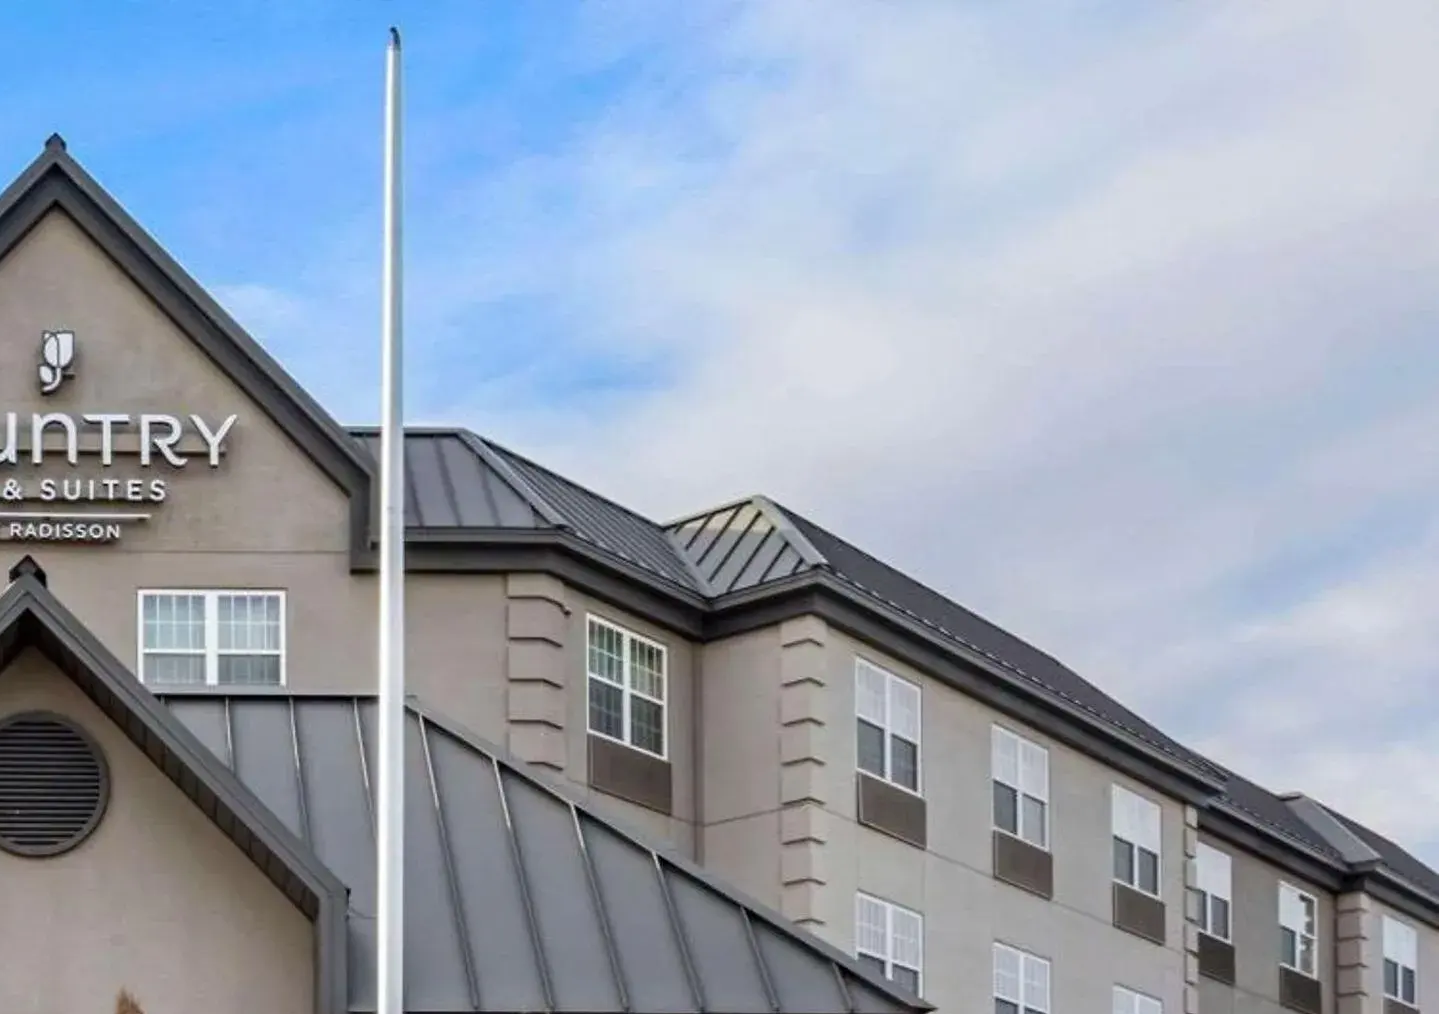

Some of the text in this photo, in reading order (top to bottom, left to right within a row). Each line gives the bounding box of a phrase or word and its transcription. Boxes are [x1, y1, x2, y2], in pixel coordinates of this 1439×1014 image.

[2, 478, 23, 500] &
[40, 479, 167, 501] SUITES
[9, 523, 121, 540] RADISSON
